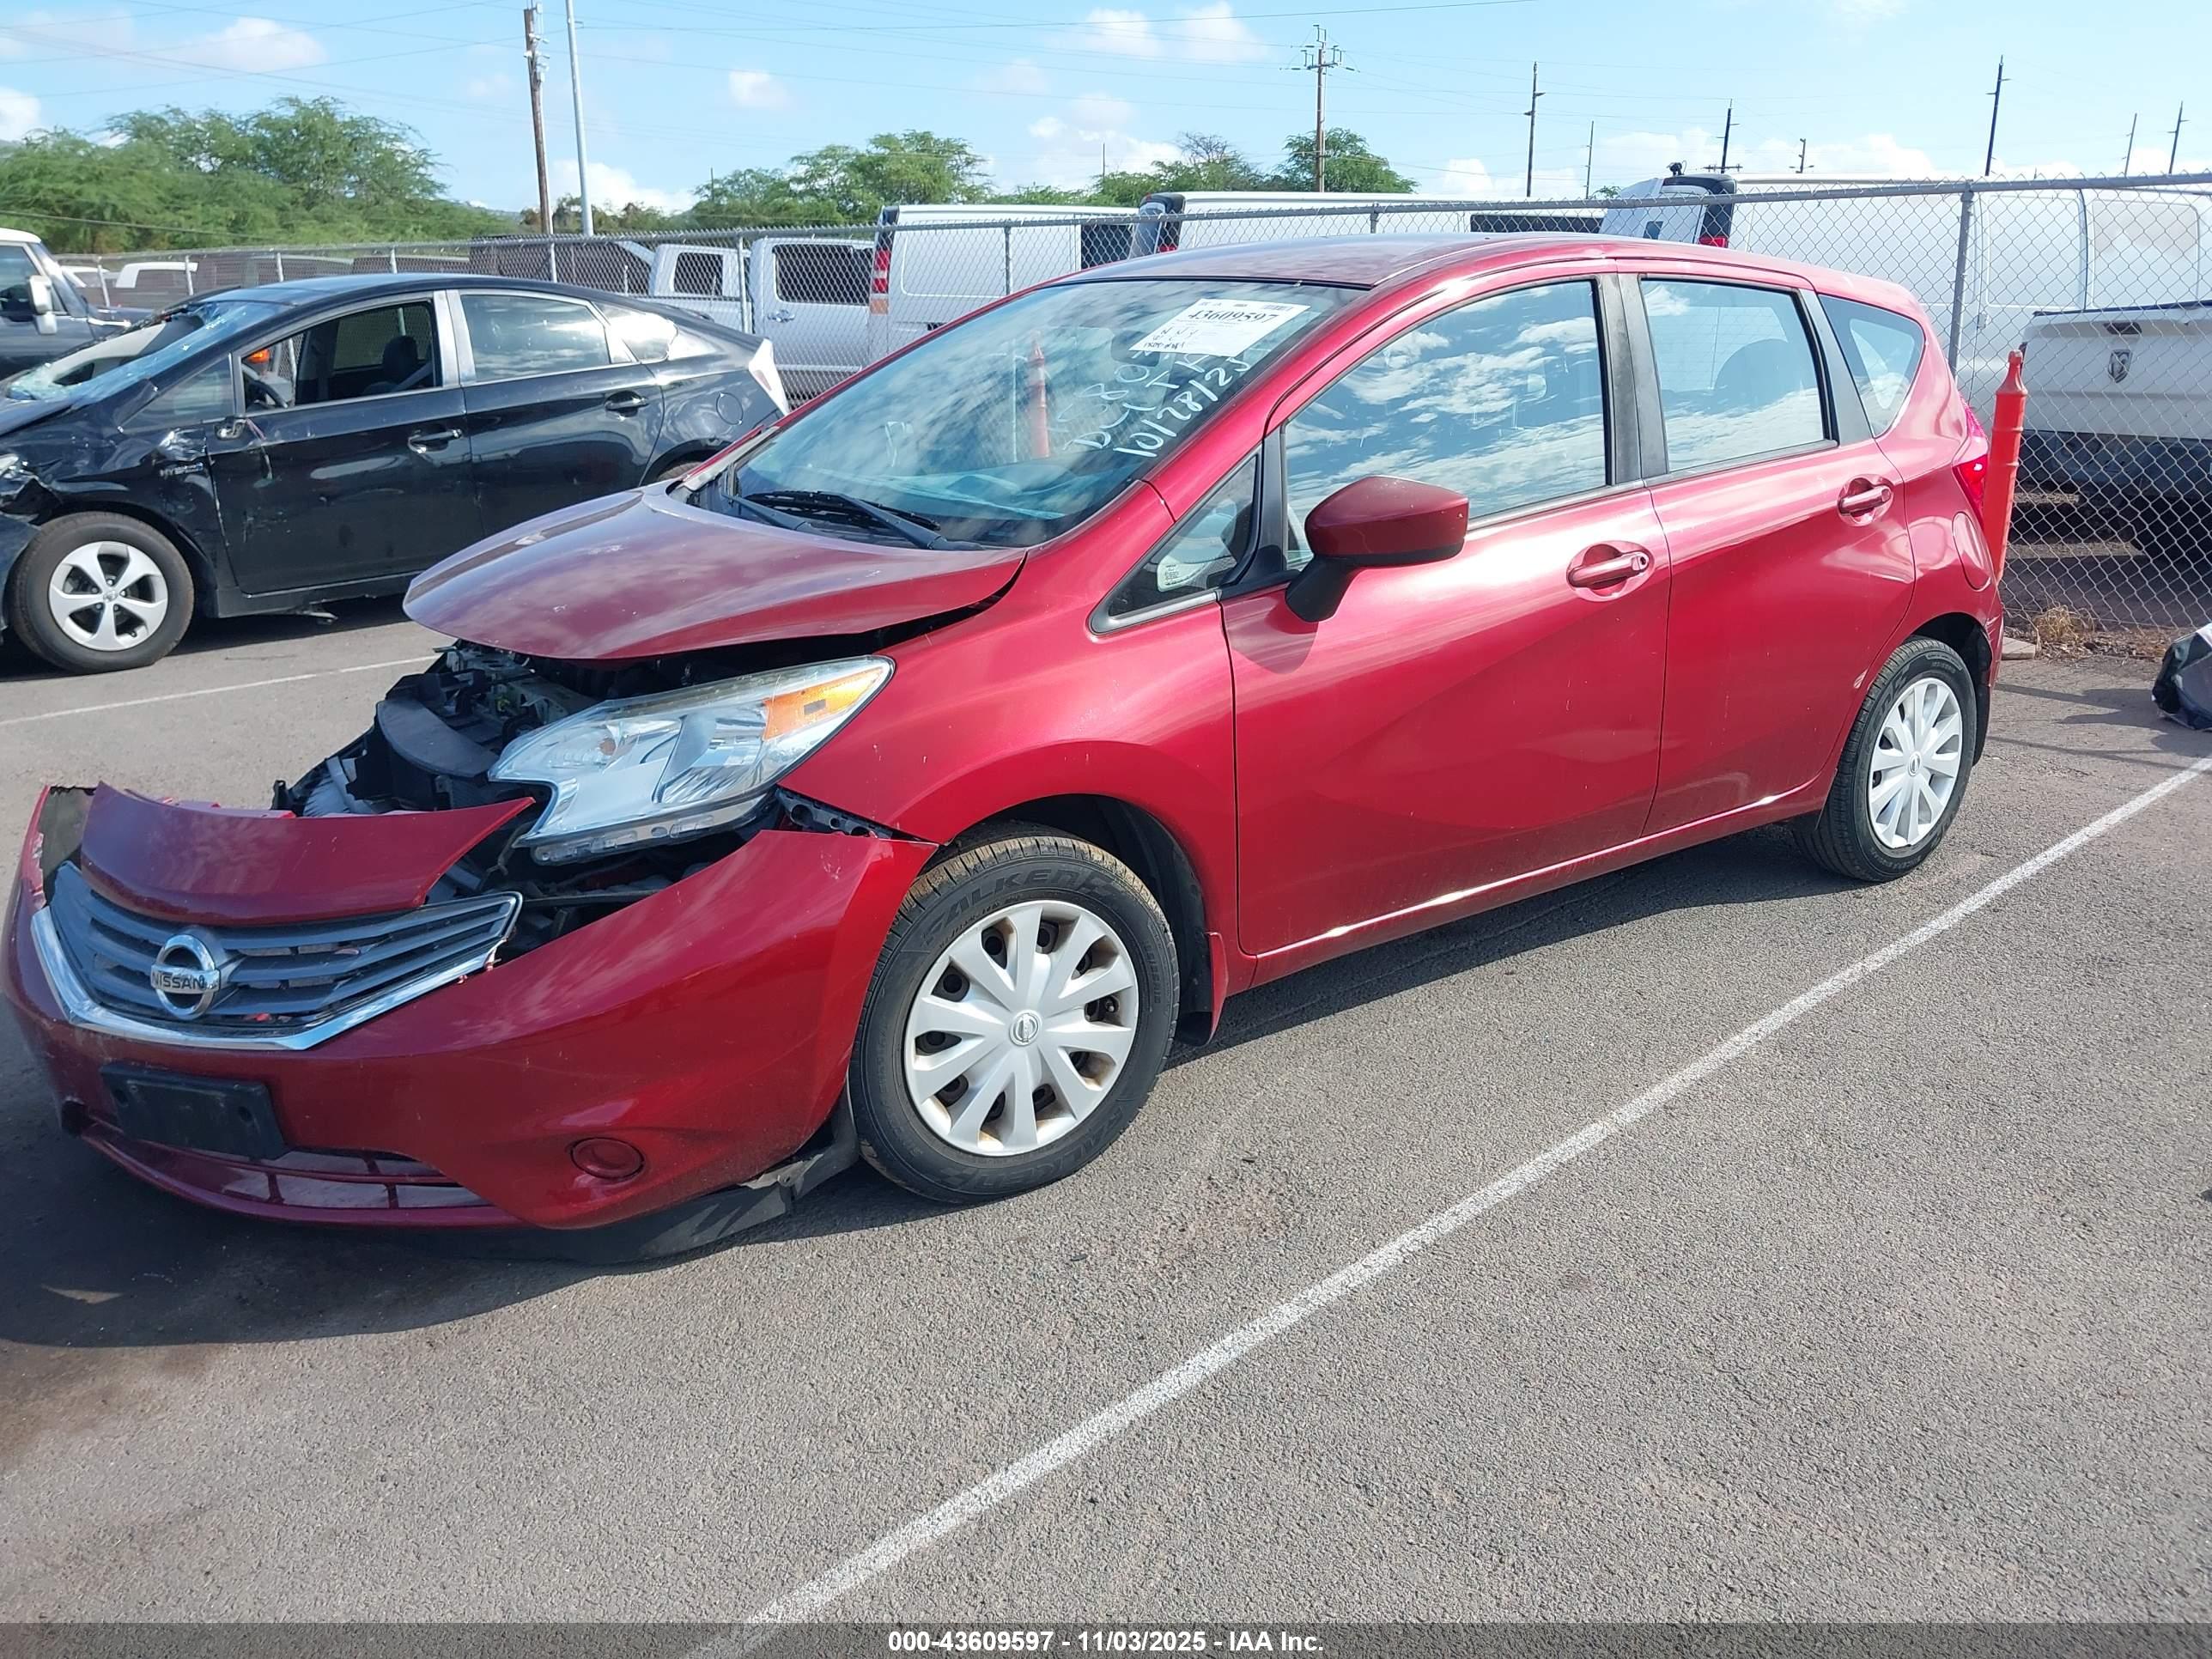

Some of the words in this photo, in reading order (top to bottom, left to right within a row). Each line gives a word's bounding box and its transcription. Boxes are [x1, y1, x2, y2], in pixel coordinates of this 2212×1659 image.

[1188, 309, 1280, 324] 43609597
[1113, 356, 1250, 458] 10/28/25
[922, 867, 1080, 945] FALKEN
[152, 971, 205, 989] NISSAN
